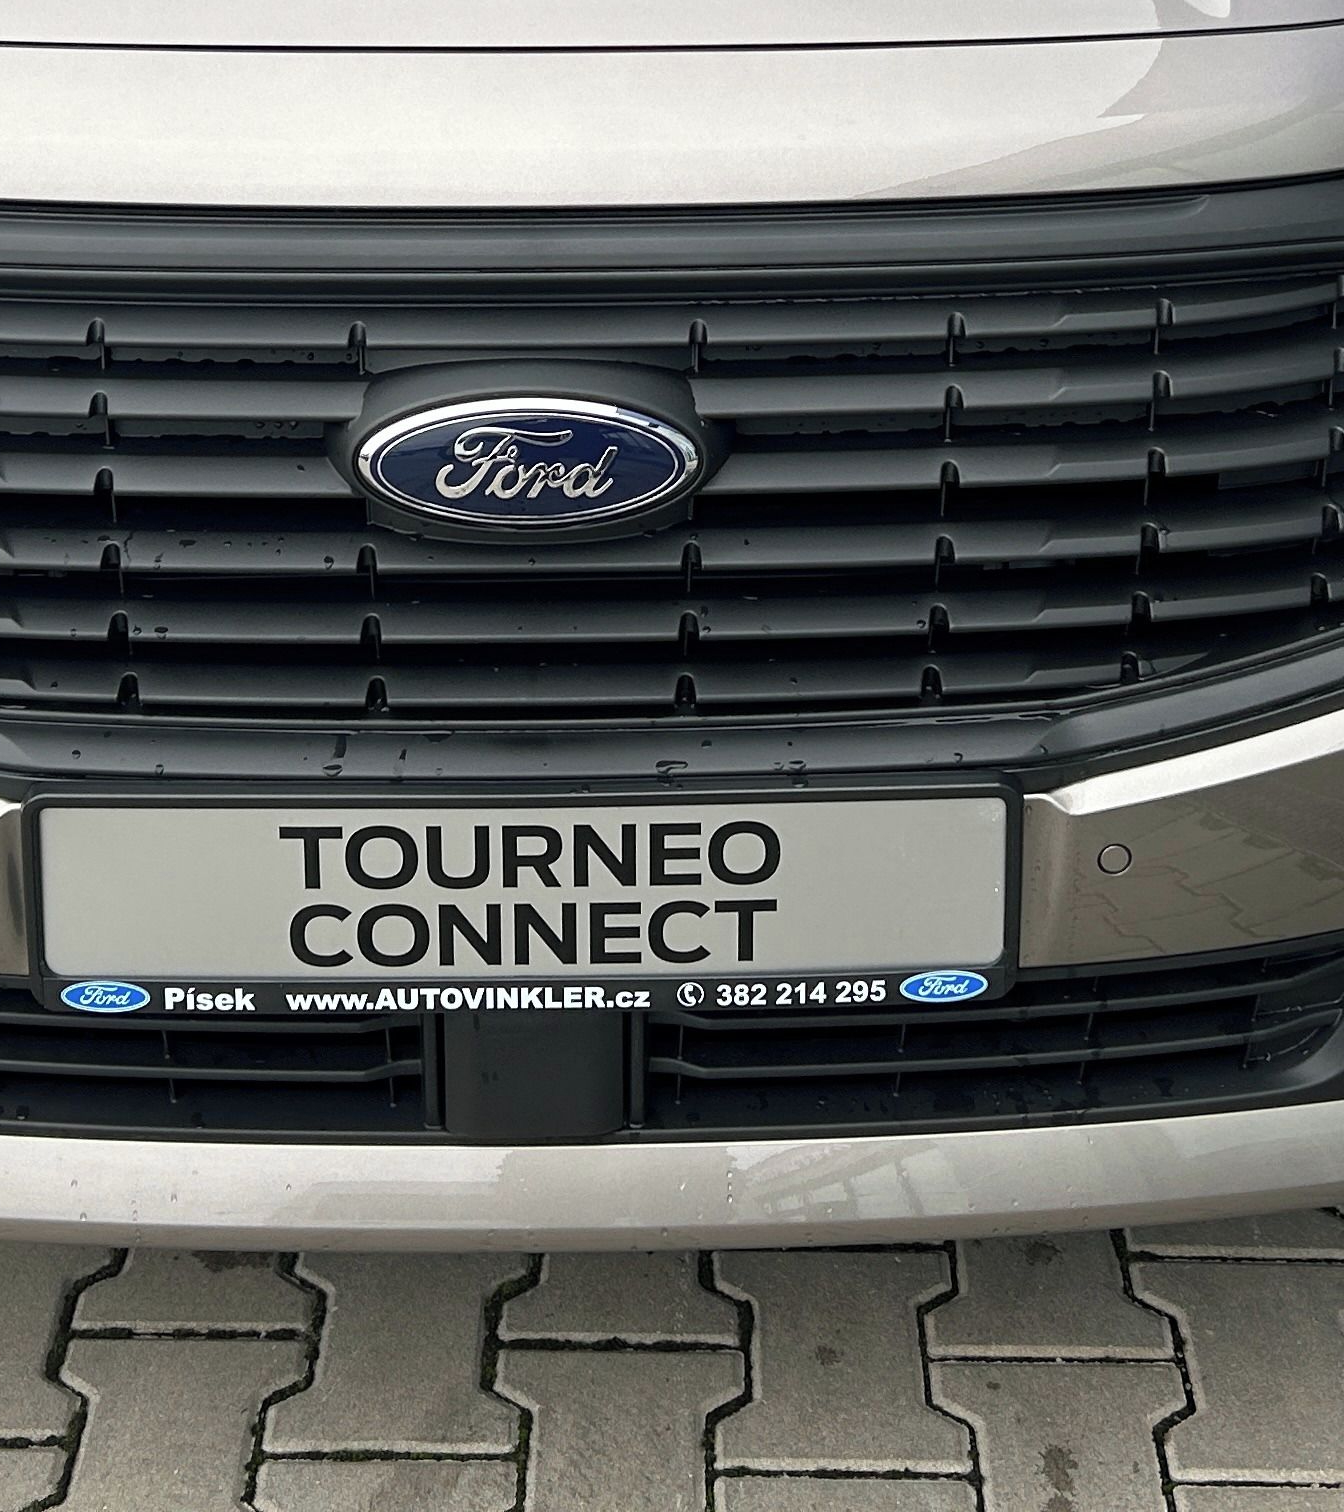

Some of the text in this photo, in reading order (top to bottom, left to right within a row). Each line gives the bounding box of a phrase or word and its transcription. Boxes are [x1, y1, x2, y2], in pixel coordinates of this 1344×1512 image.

[435, 426, 618, 499] Ford
[278, 820, 782, 891] TOURNEO
[288, 897, 779, 969] CONNECT
[164, 987, 256, 1011] Písek
[286, 982, 651, 1011] www.AUTOVINKLER.cz
[716, 983, 767, 1006] 382
[776, 982, 827, 1004] 214
[835, 979, 886, 1003] 295
